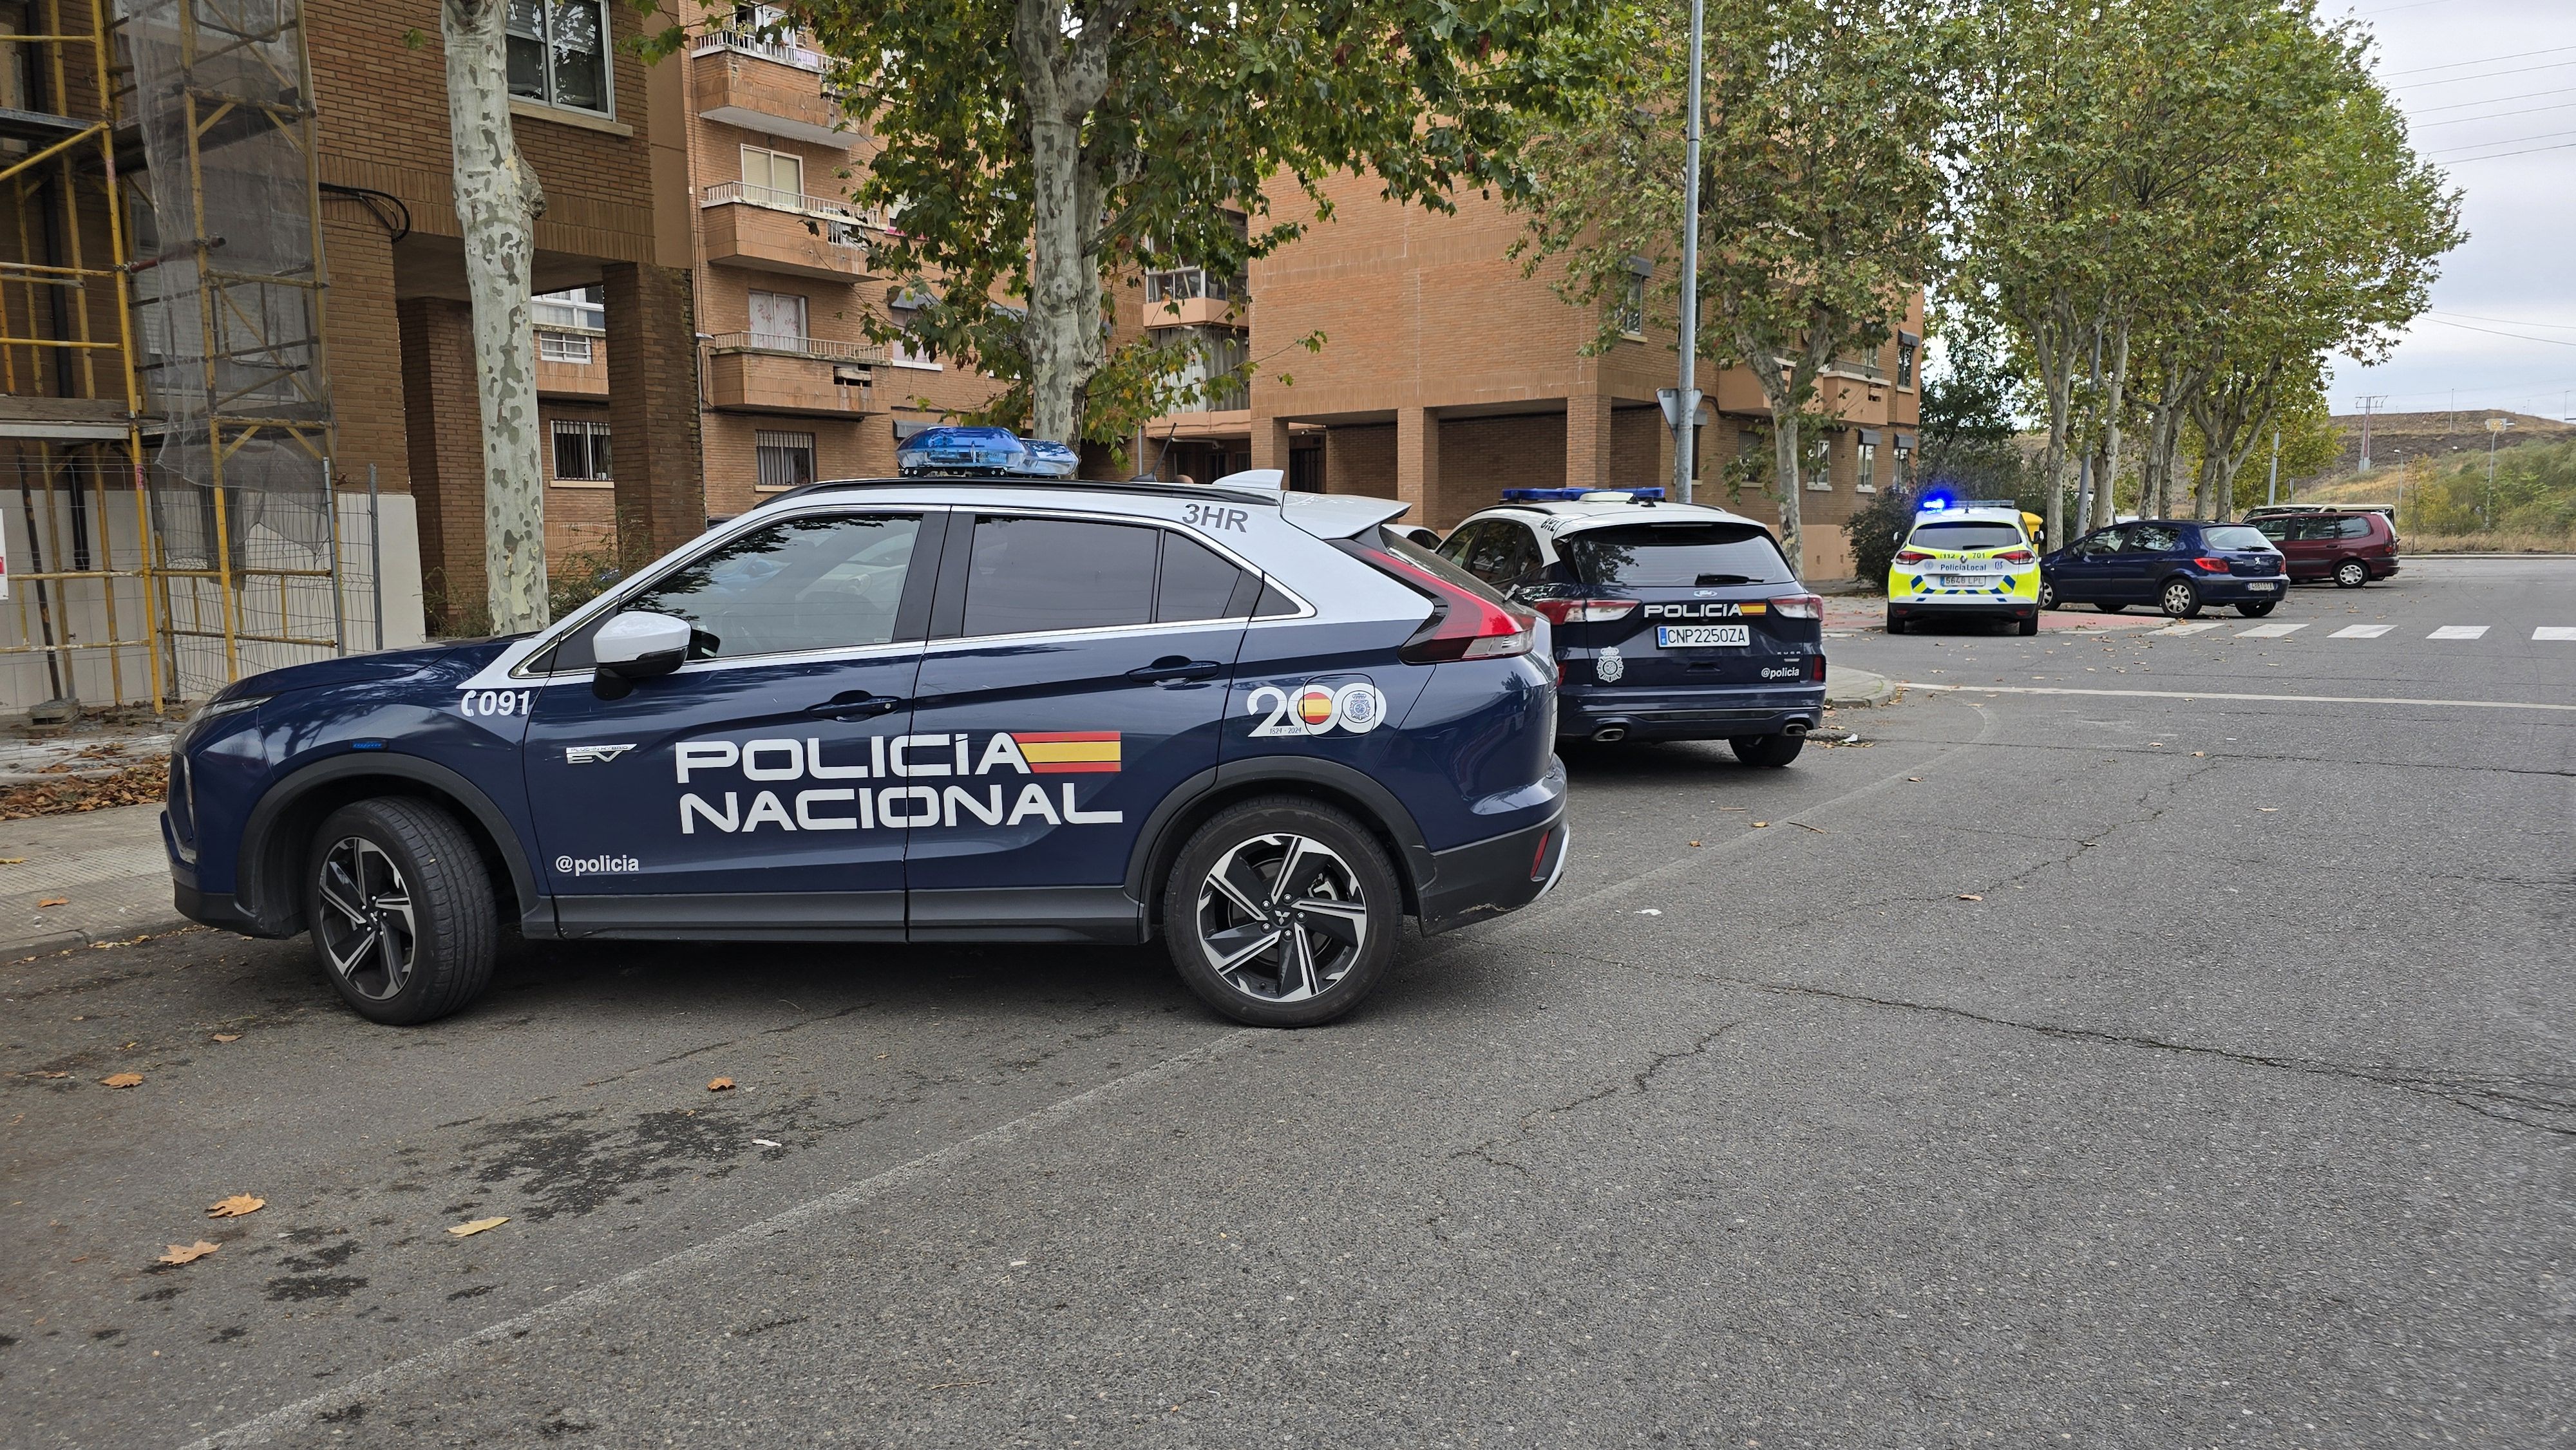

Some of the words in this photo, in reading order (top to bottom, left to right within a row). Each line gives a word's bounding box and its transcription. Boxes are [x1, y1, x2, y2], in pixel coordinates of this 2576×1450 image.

[1182, 504, 1249, 533] 3HR
[1667, 628, 1746, 643] CNP2250ZA
[1761, 667, 1800, 679] @policia
[478, 691, 530, 716] 091
[680, 782, 1122, 834] NACIONAL
[556, 854, 639, 876] @policia
